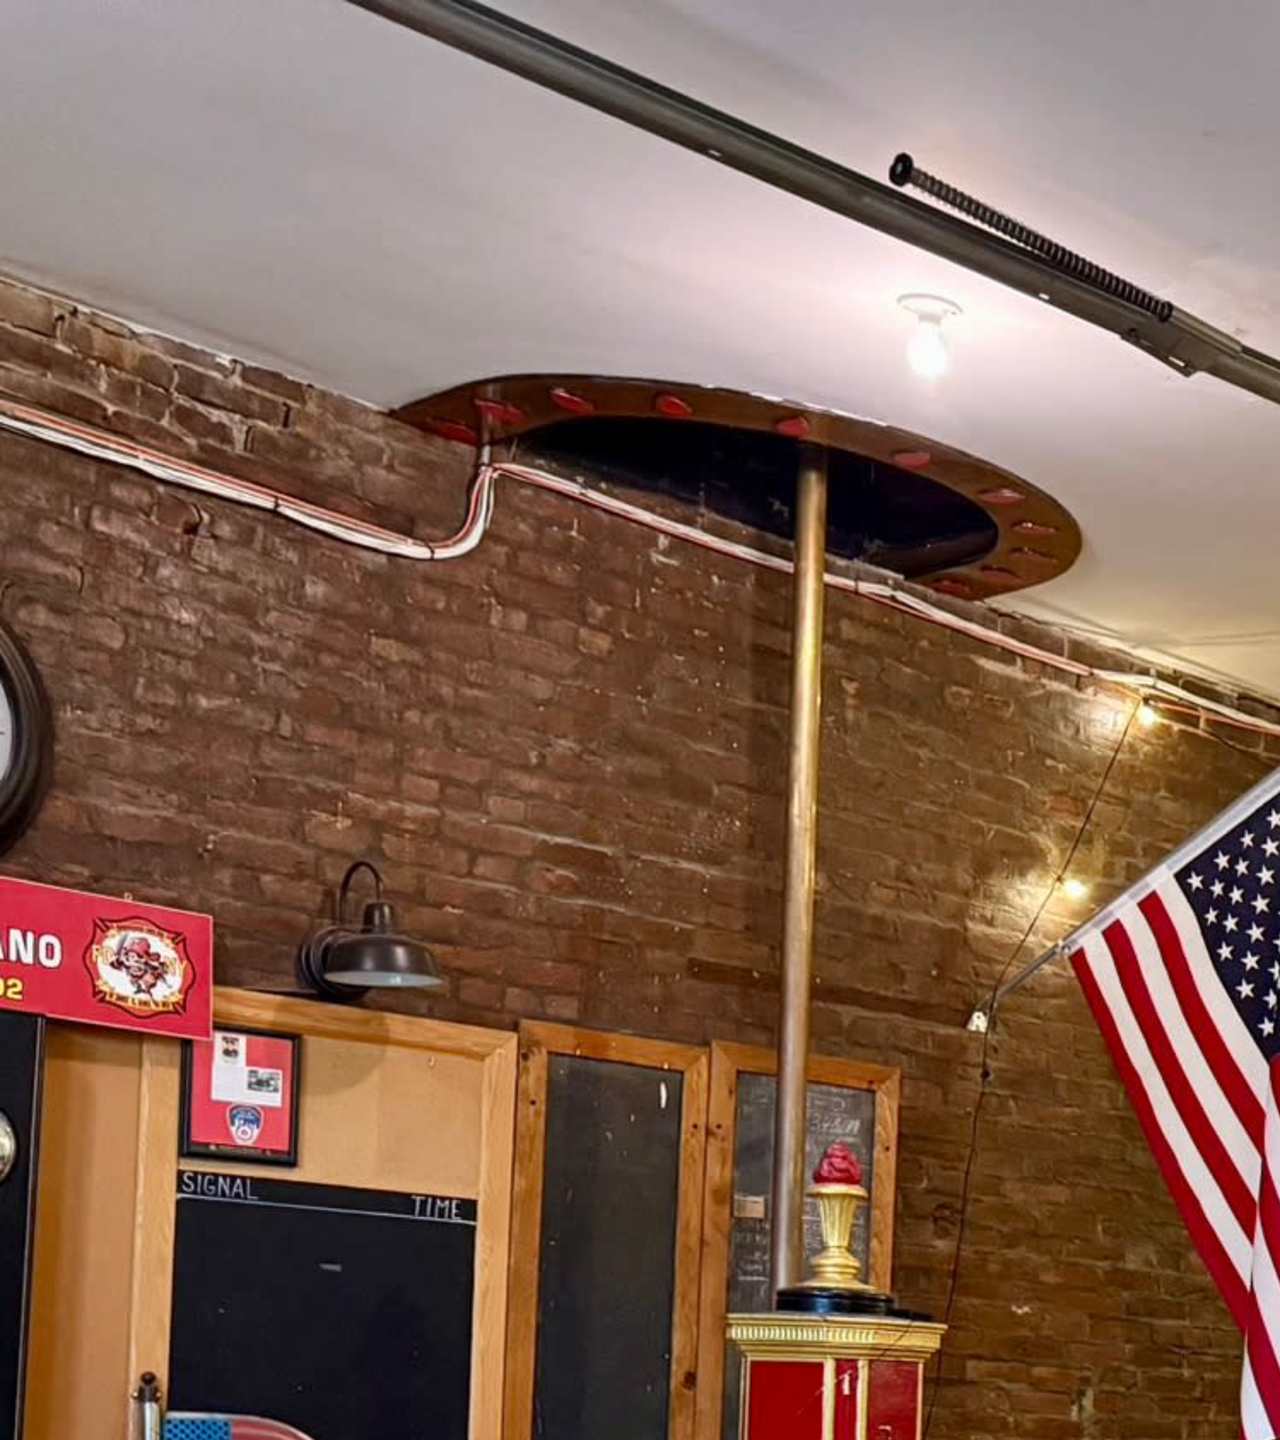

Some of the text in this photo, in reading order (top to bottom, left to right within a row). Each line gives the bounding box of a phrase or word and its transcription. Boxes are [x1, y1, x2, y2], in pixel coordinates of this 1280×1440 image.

[0, 928, 62, 969] NO
[181, 1171, 463, 1221] SIGNAL TIME
